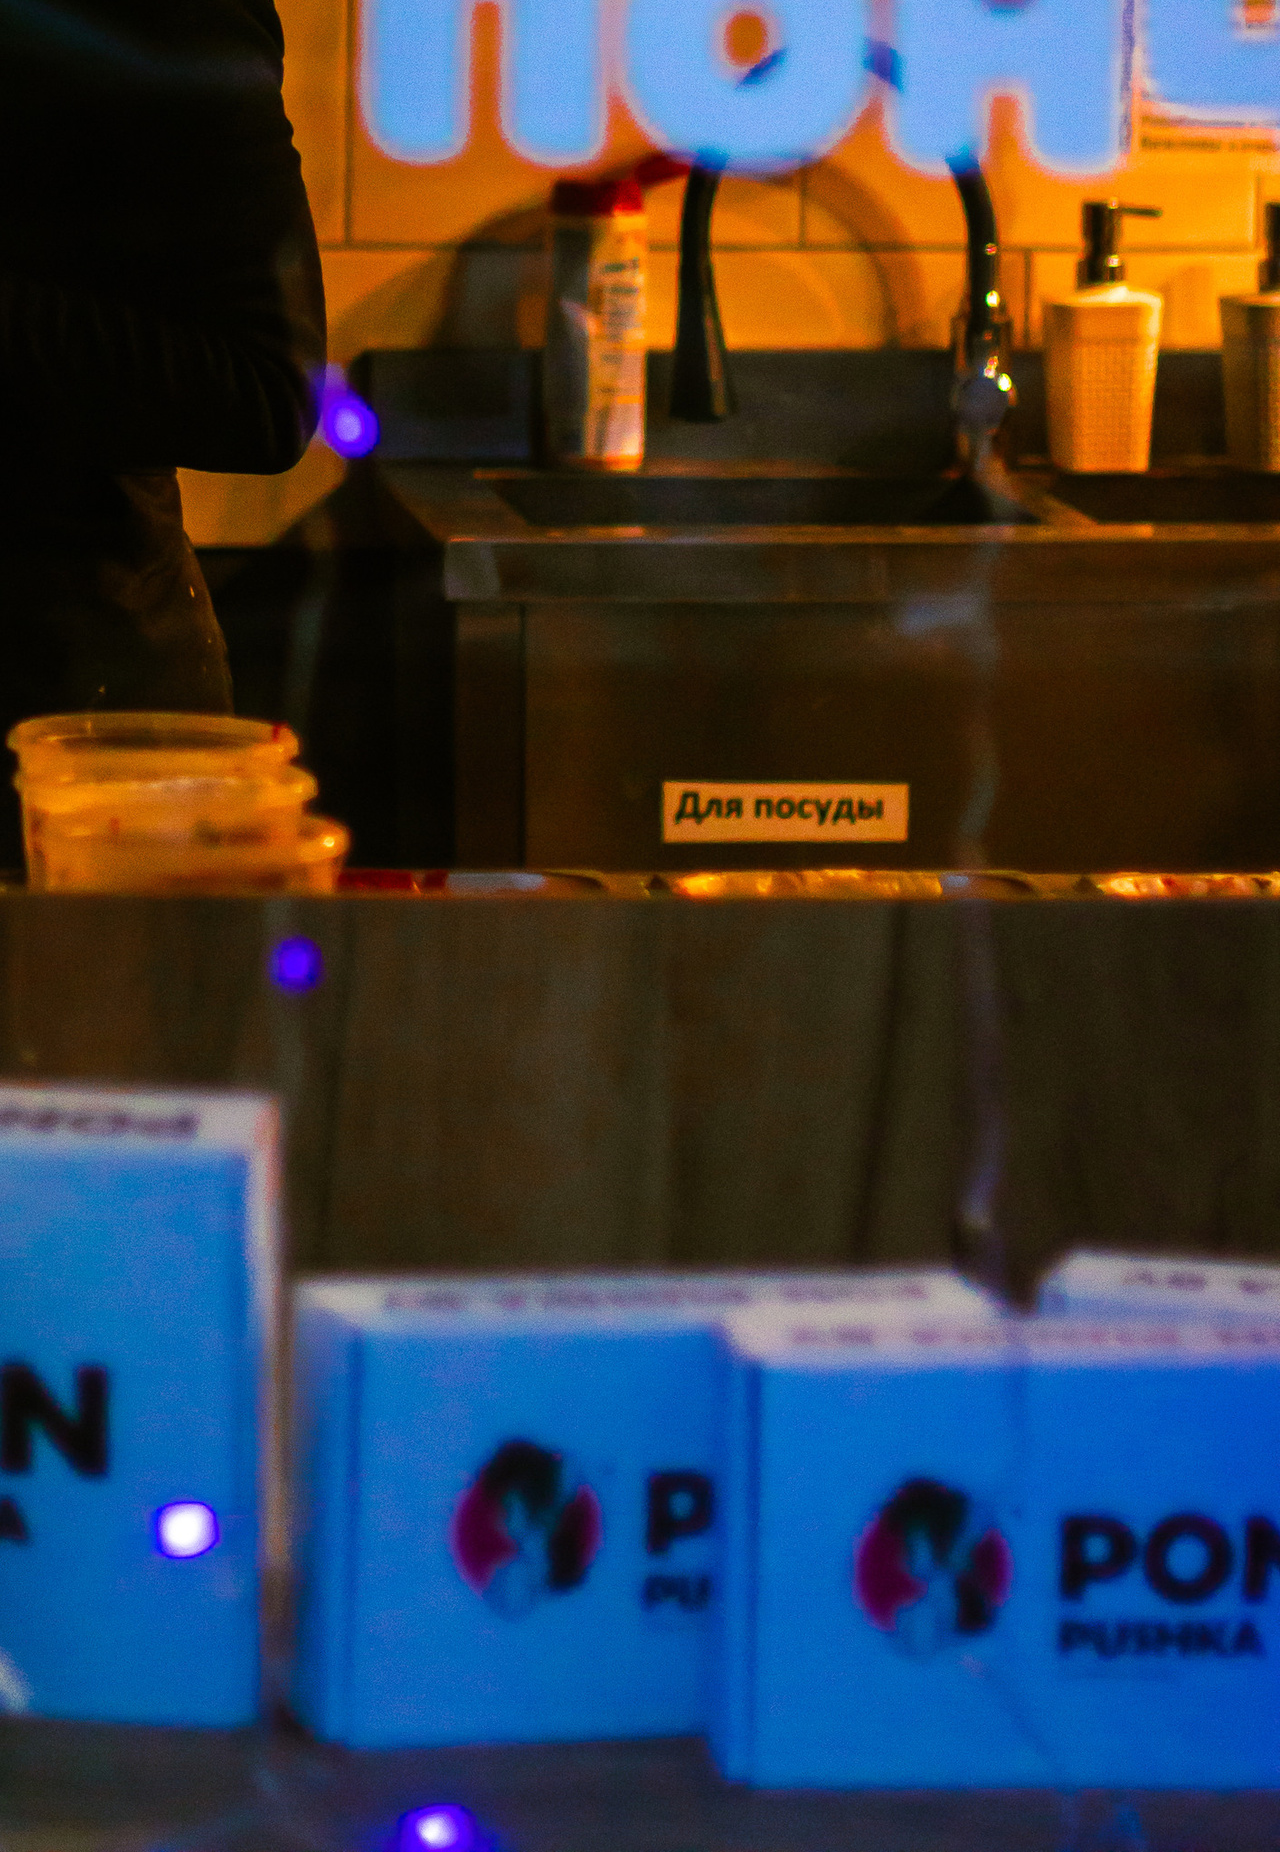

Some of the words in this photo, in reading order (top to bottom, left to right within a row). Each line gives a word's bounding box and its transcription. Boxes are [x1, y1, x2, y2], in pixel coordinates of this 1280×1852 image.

[674, 790, 743, 826] Для
[754, 797, 884, 826] посуды
[646, 1468, 714, 1554] P
